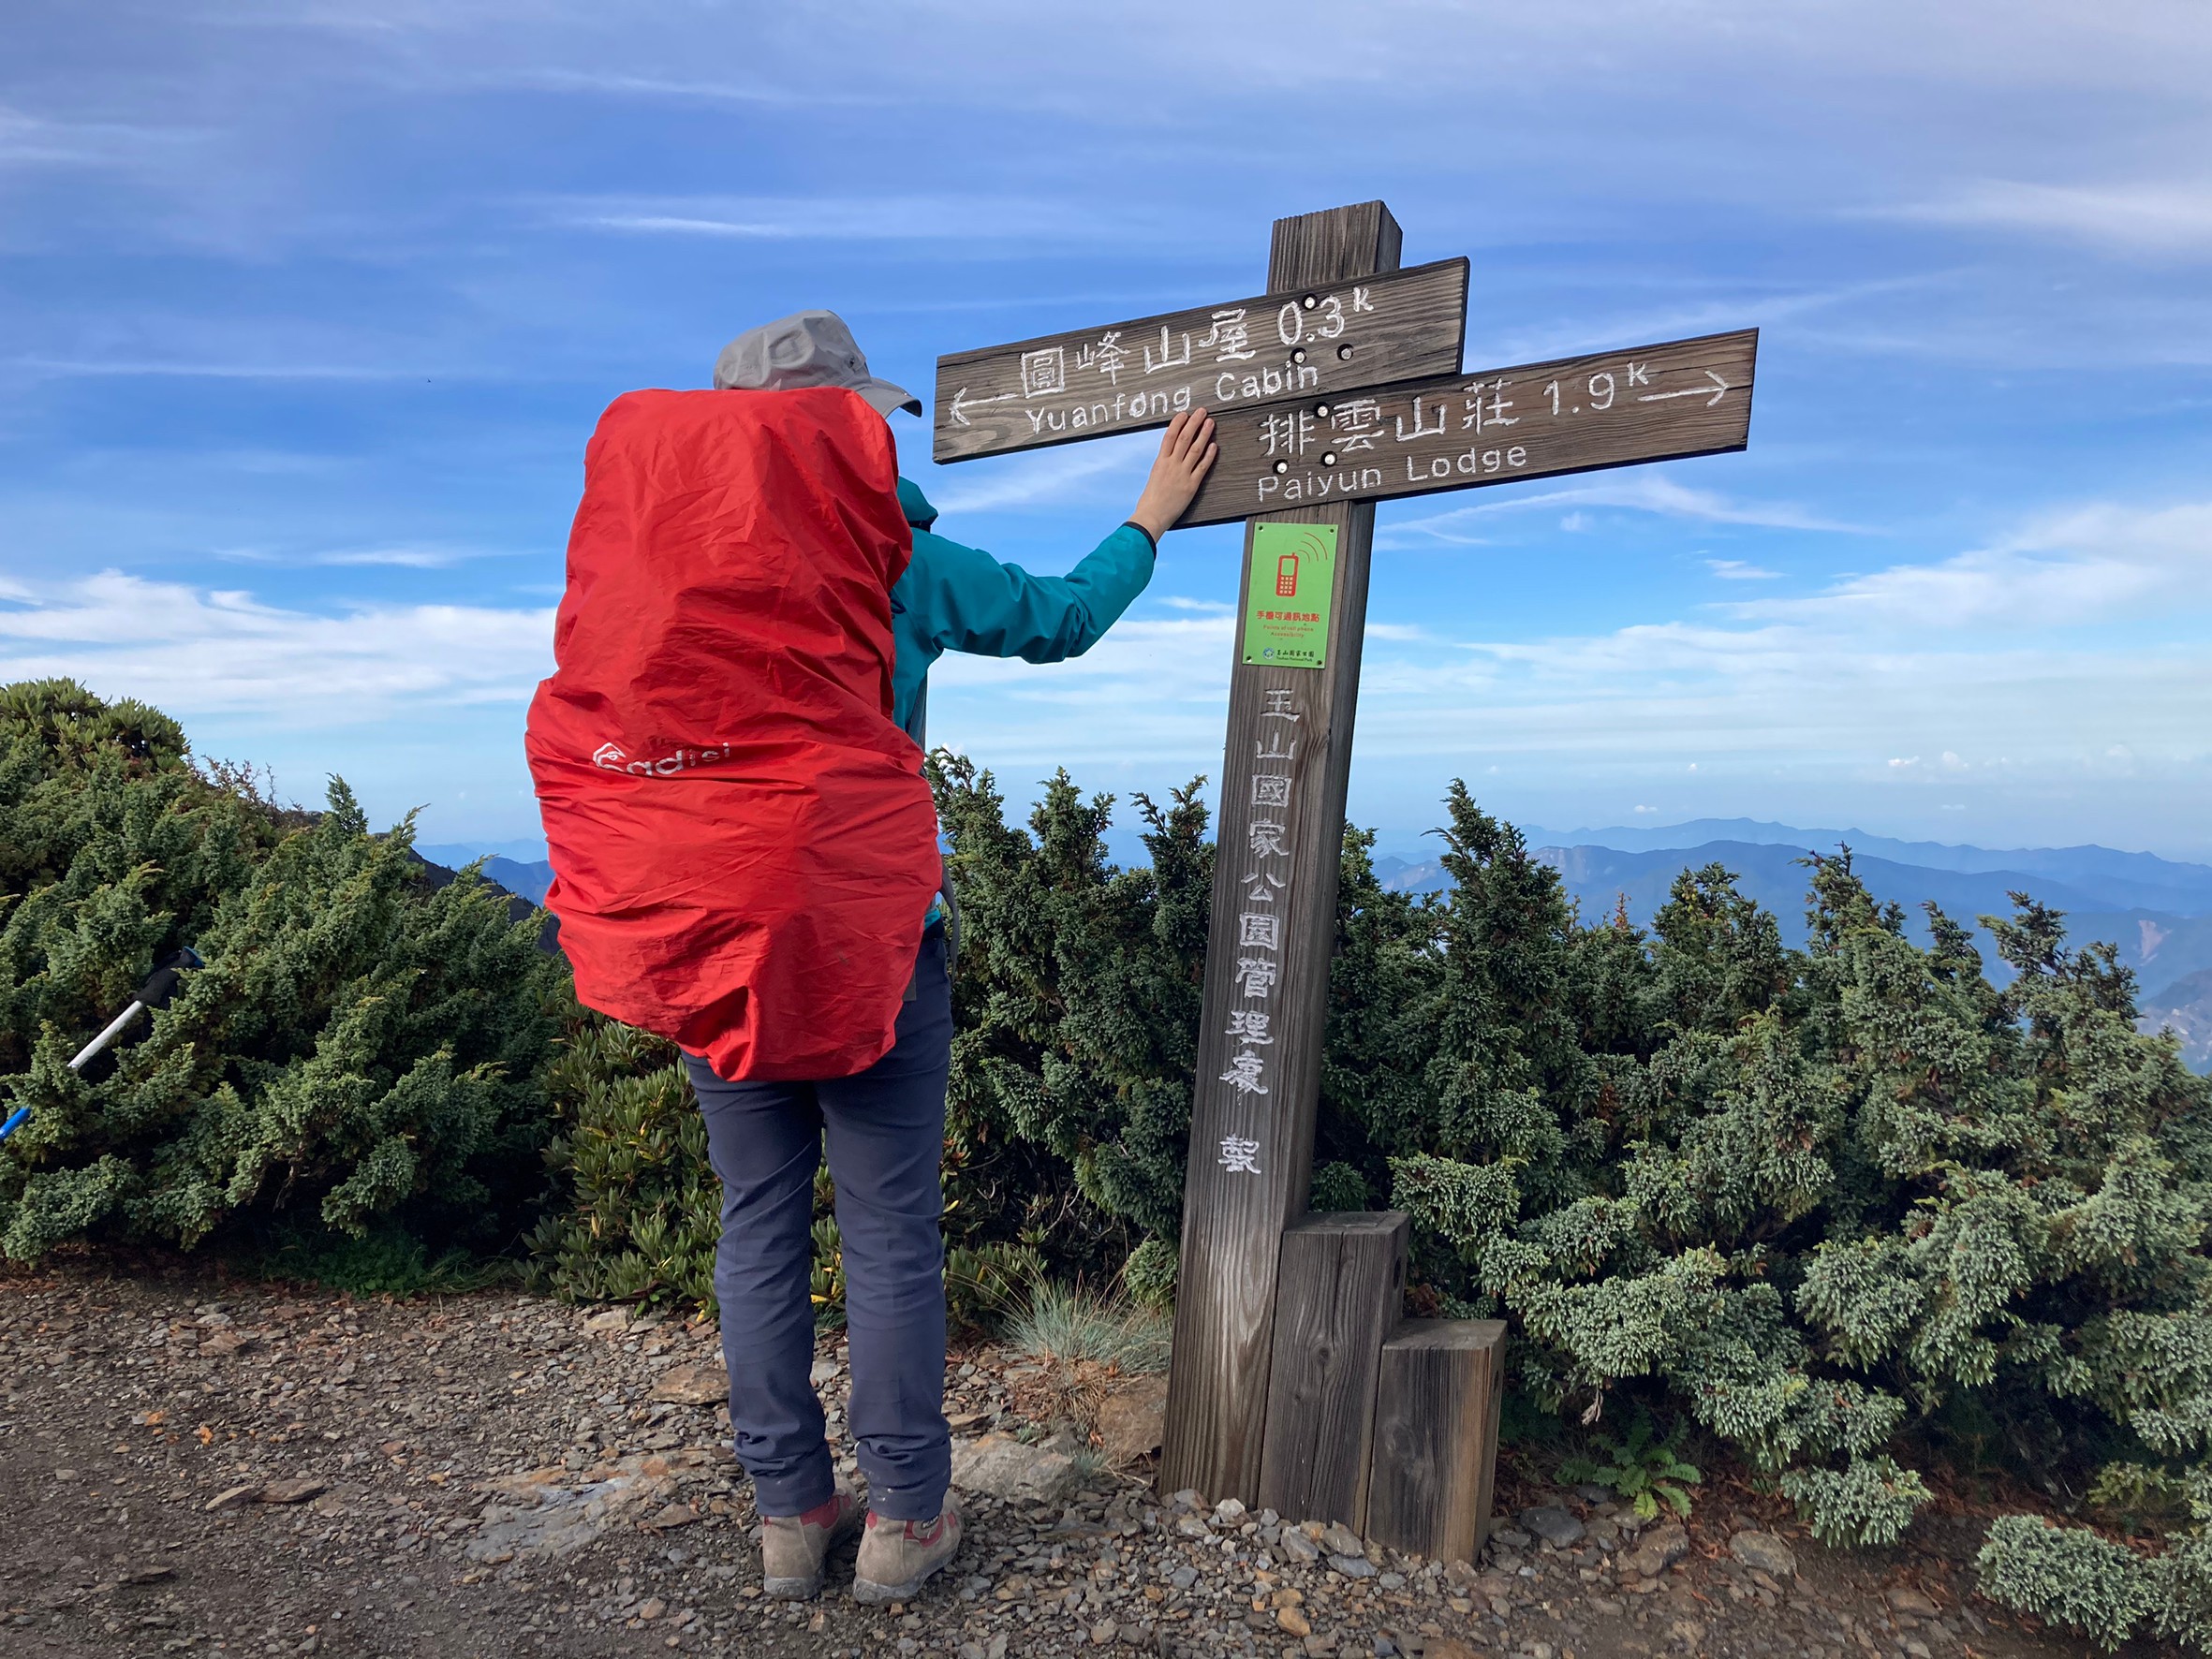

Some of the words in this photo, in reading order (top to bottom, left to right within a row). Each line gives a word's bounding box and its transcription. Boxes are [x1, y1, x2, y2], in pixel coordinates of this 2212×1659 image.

[1020, 308, 1256, 400] 圓峰山屋
[1025, 386, 1192, 434] Yuanfong
[1216, 362, 1319, 402] Cabin
[1258, 378, 1520, 456] 排雲山莊
[1258, 466, 1382, 503] Paiyun
[1406, 445, 1527, 481] Lodge
